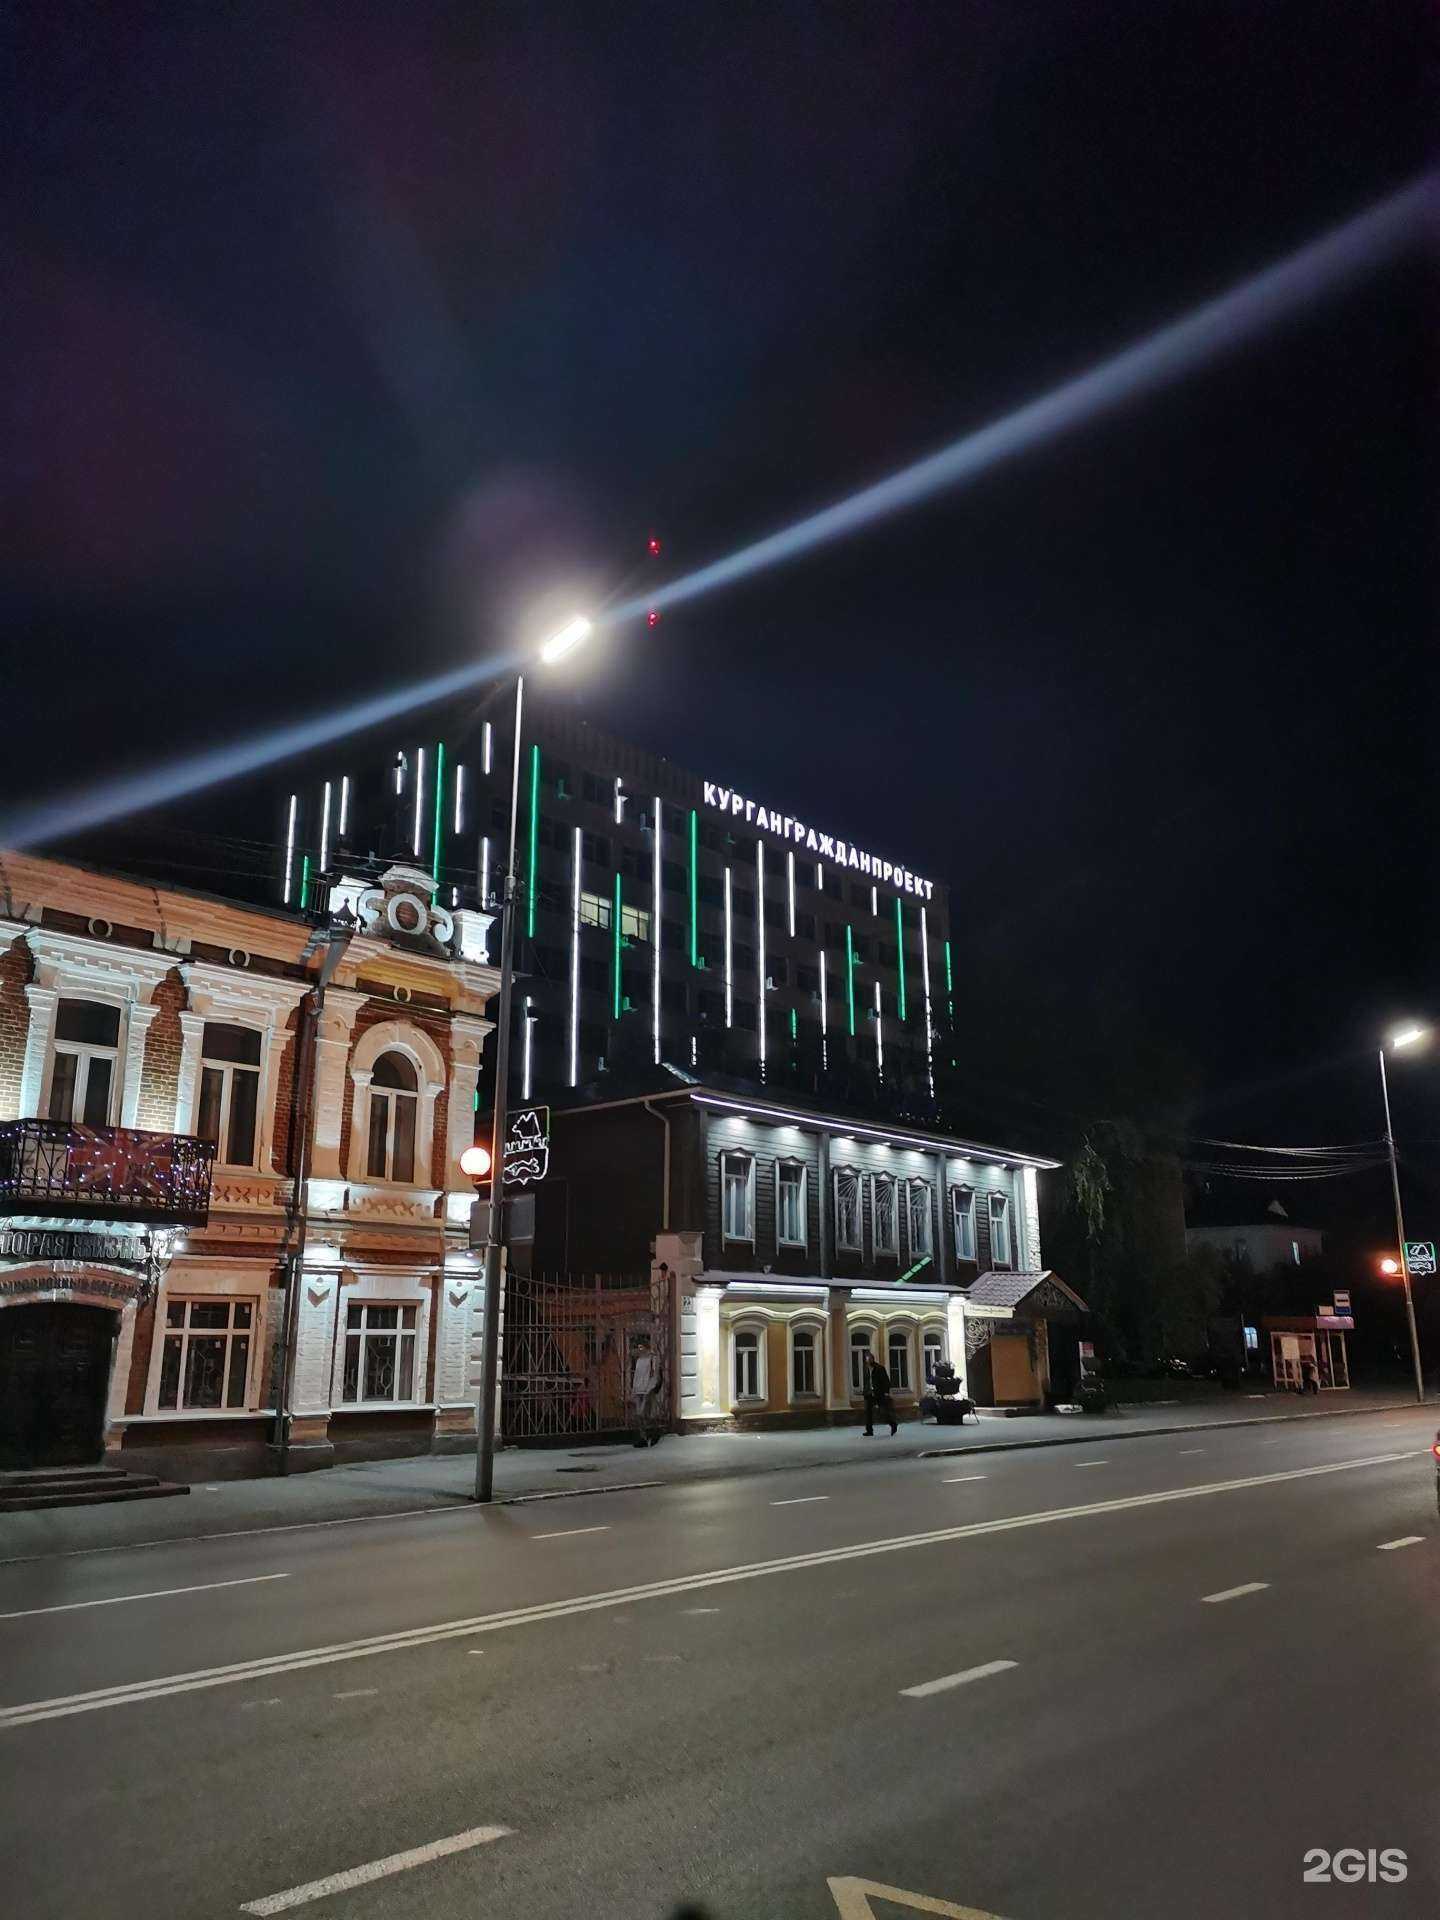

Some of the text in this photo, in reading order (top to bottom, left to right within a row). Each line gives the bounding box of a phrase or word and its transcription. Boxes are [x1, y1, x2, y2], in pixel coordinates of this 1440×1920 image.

[704, 780, 934, 901] КУРГАНГРАЖДАНПРОЕКТ
[0, 1231, 146, 1260] ТОРАЯ ЖИЗНЬ
